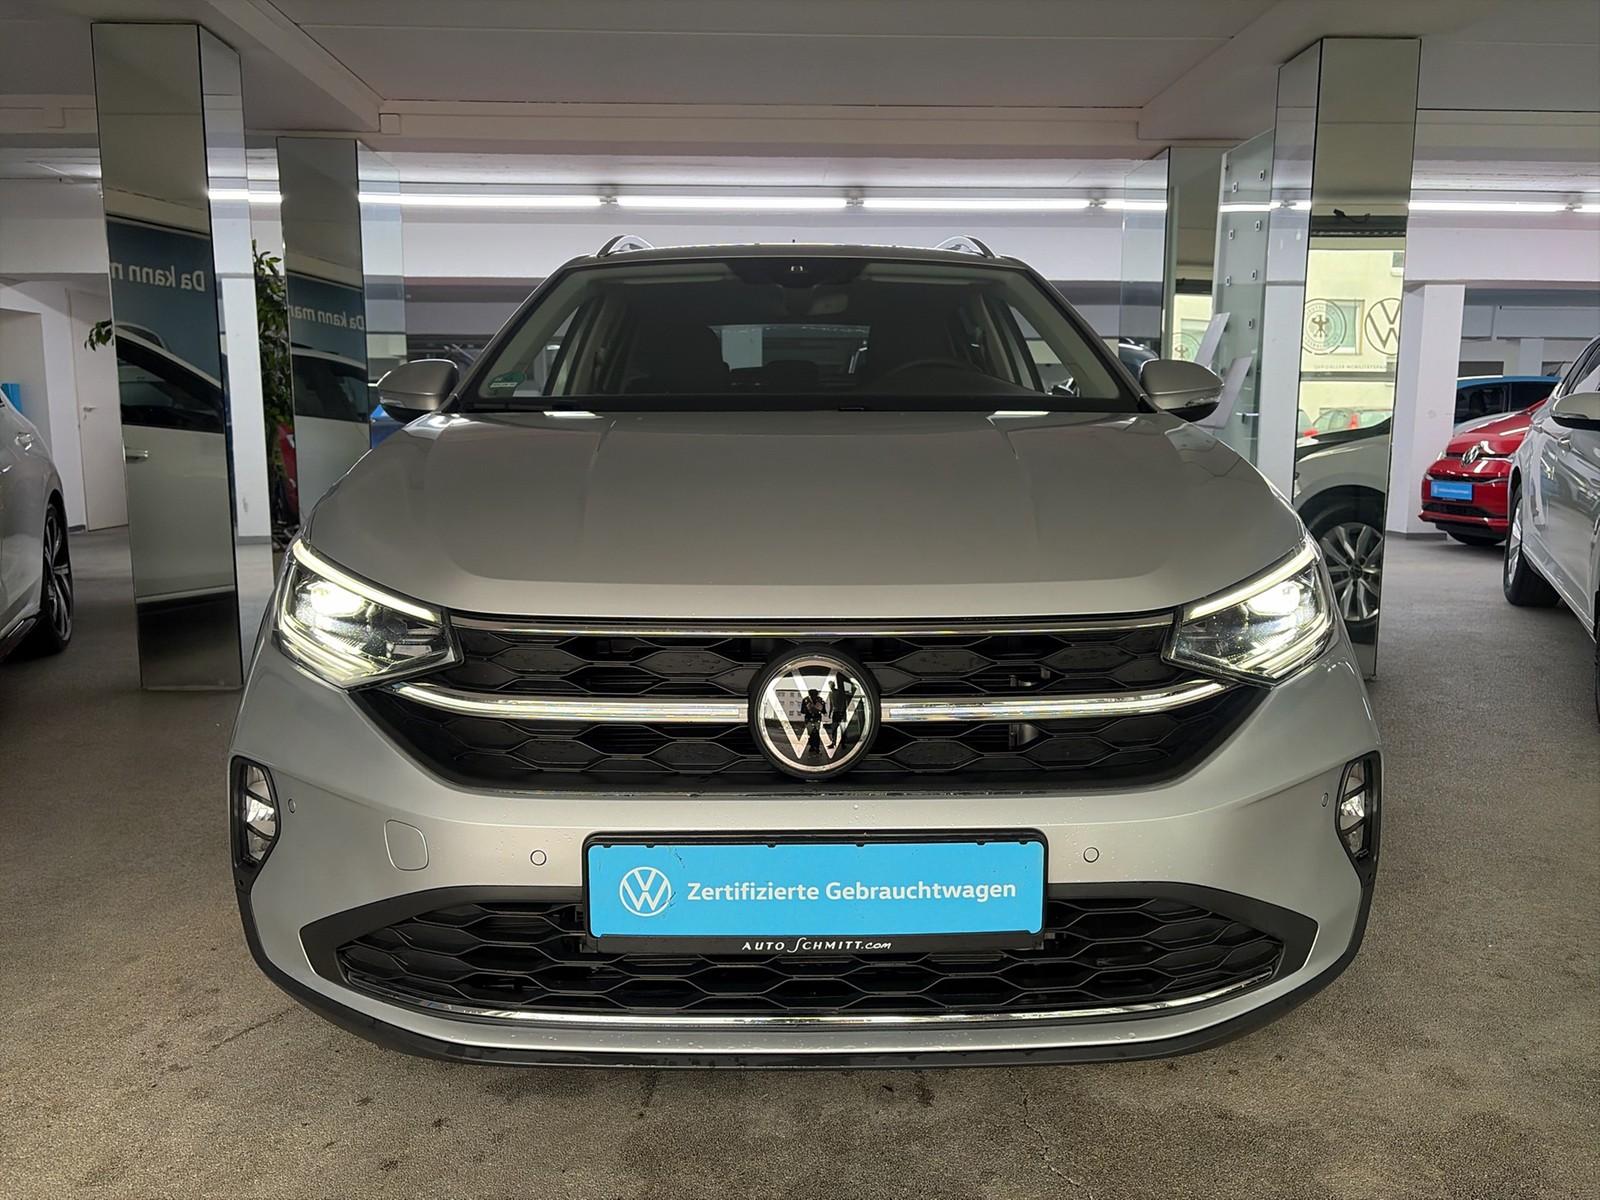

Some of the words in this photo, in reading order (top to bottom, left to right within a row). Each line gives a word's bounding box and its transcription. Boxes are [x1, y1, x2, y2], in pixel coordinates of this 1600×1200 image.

[621, 868, 670, 914] VW
[687, 881, 820, 902] Zertifizierte
[825, 880, 1017, 903] Gebrauchtwagen
[741, 941, 786, 951] AUTO
[786, 937, 893, 953] SCHMITT.com
